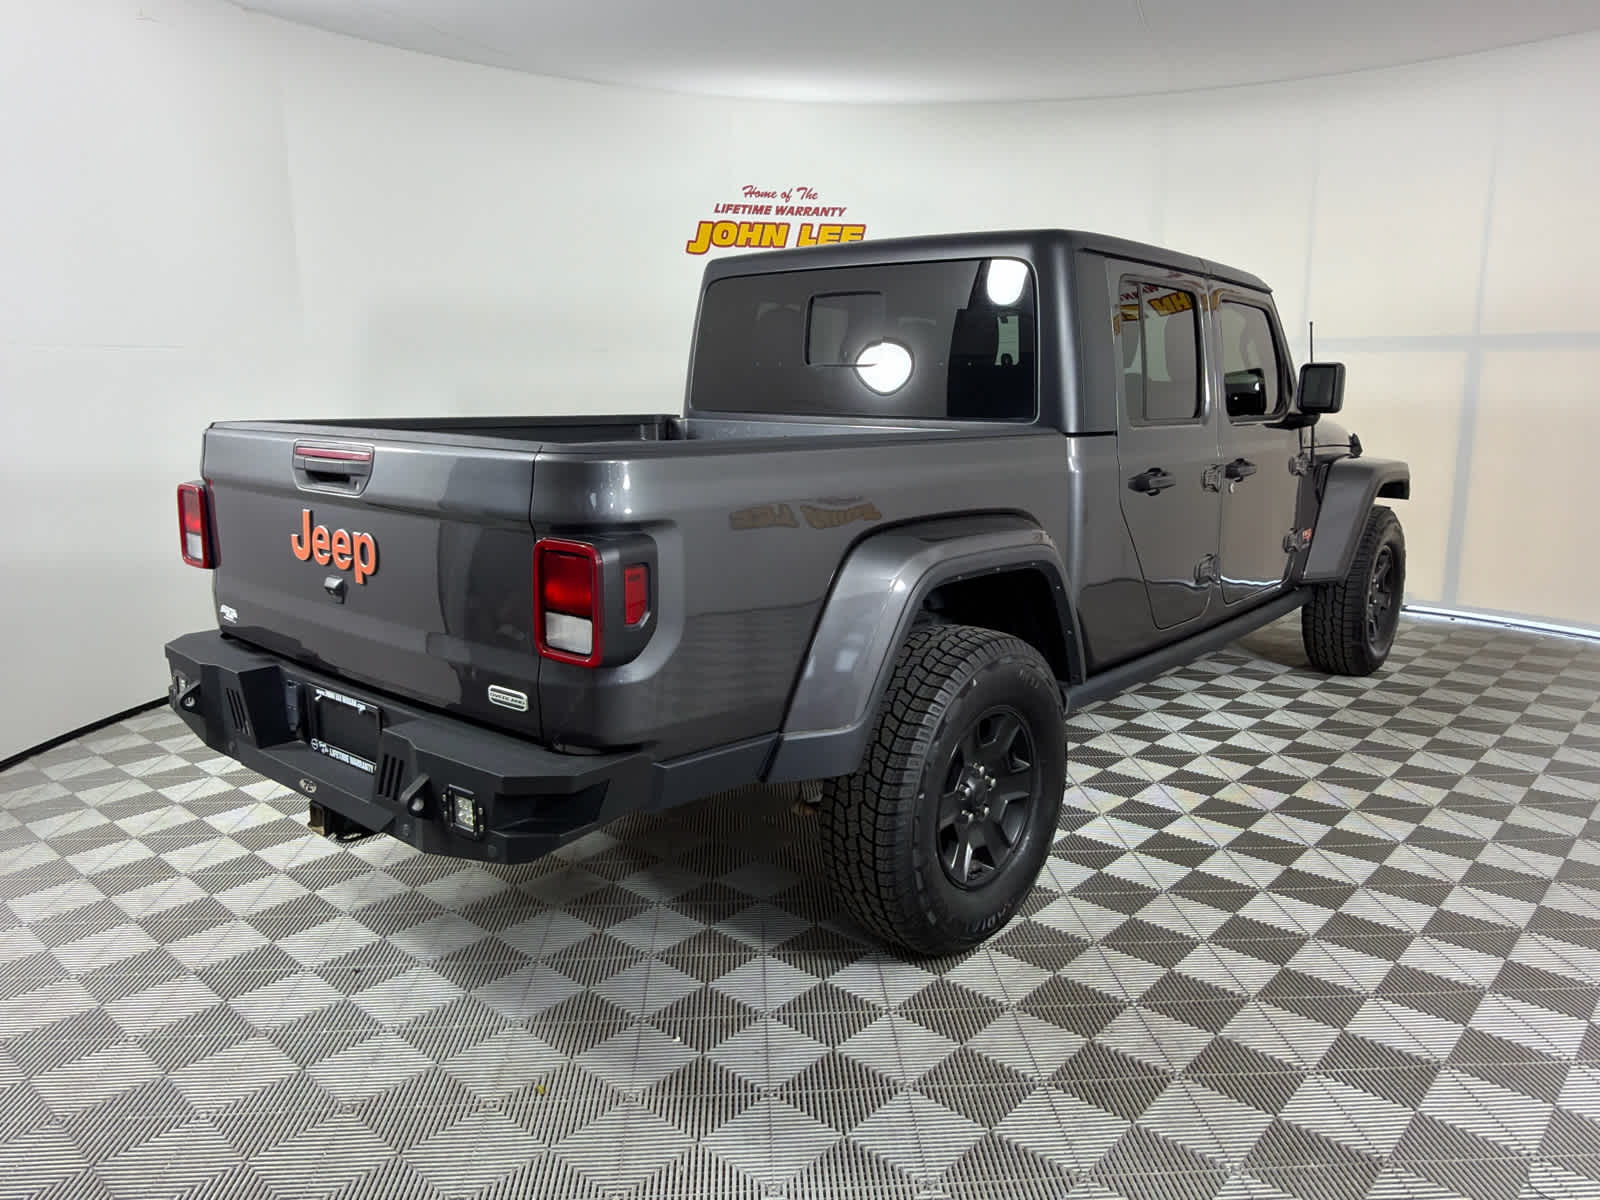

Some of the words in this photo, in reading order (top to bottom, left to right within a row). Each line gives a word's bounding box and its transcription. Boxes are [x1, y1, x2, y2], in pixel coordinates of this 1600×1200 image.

[742, 184, 778, 199] Home
[780, 188, 793, 204] of
[796, 186, 819, 200] The
[714, 203, 772, 216] LIFETIME
[775, 205, 847, 217] WARRANTY
[686, 220, 791, 255] JOHN
[797, 223, 867, 247] LEE
[291, 508, 377, 585] Jeep
